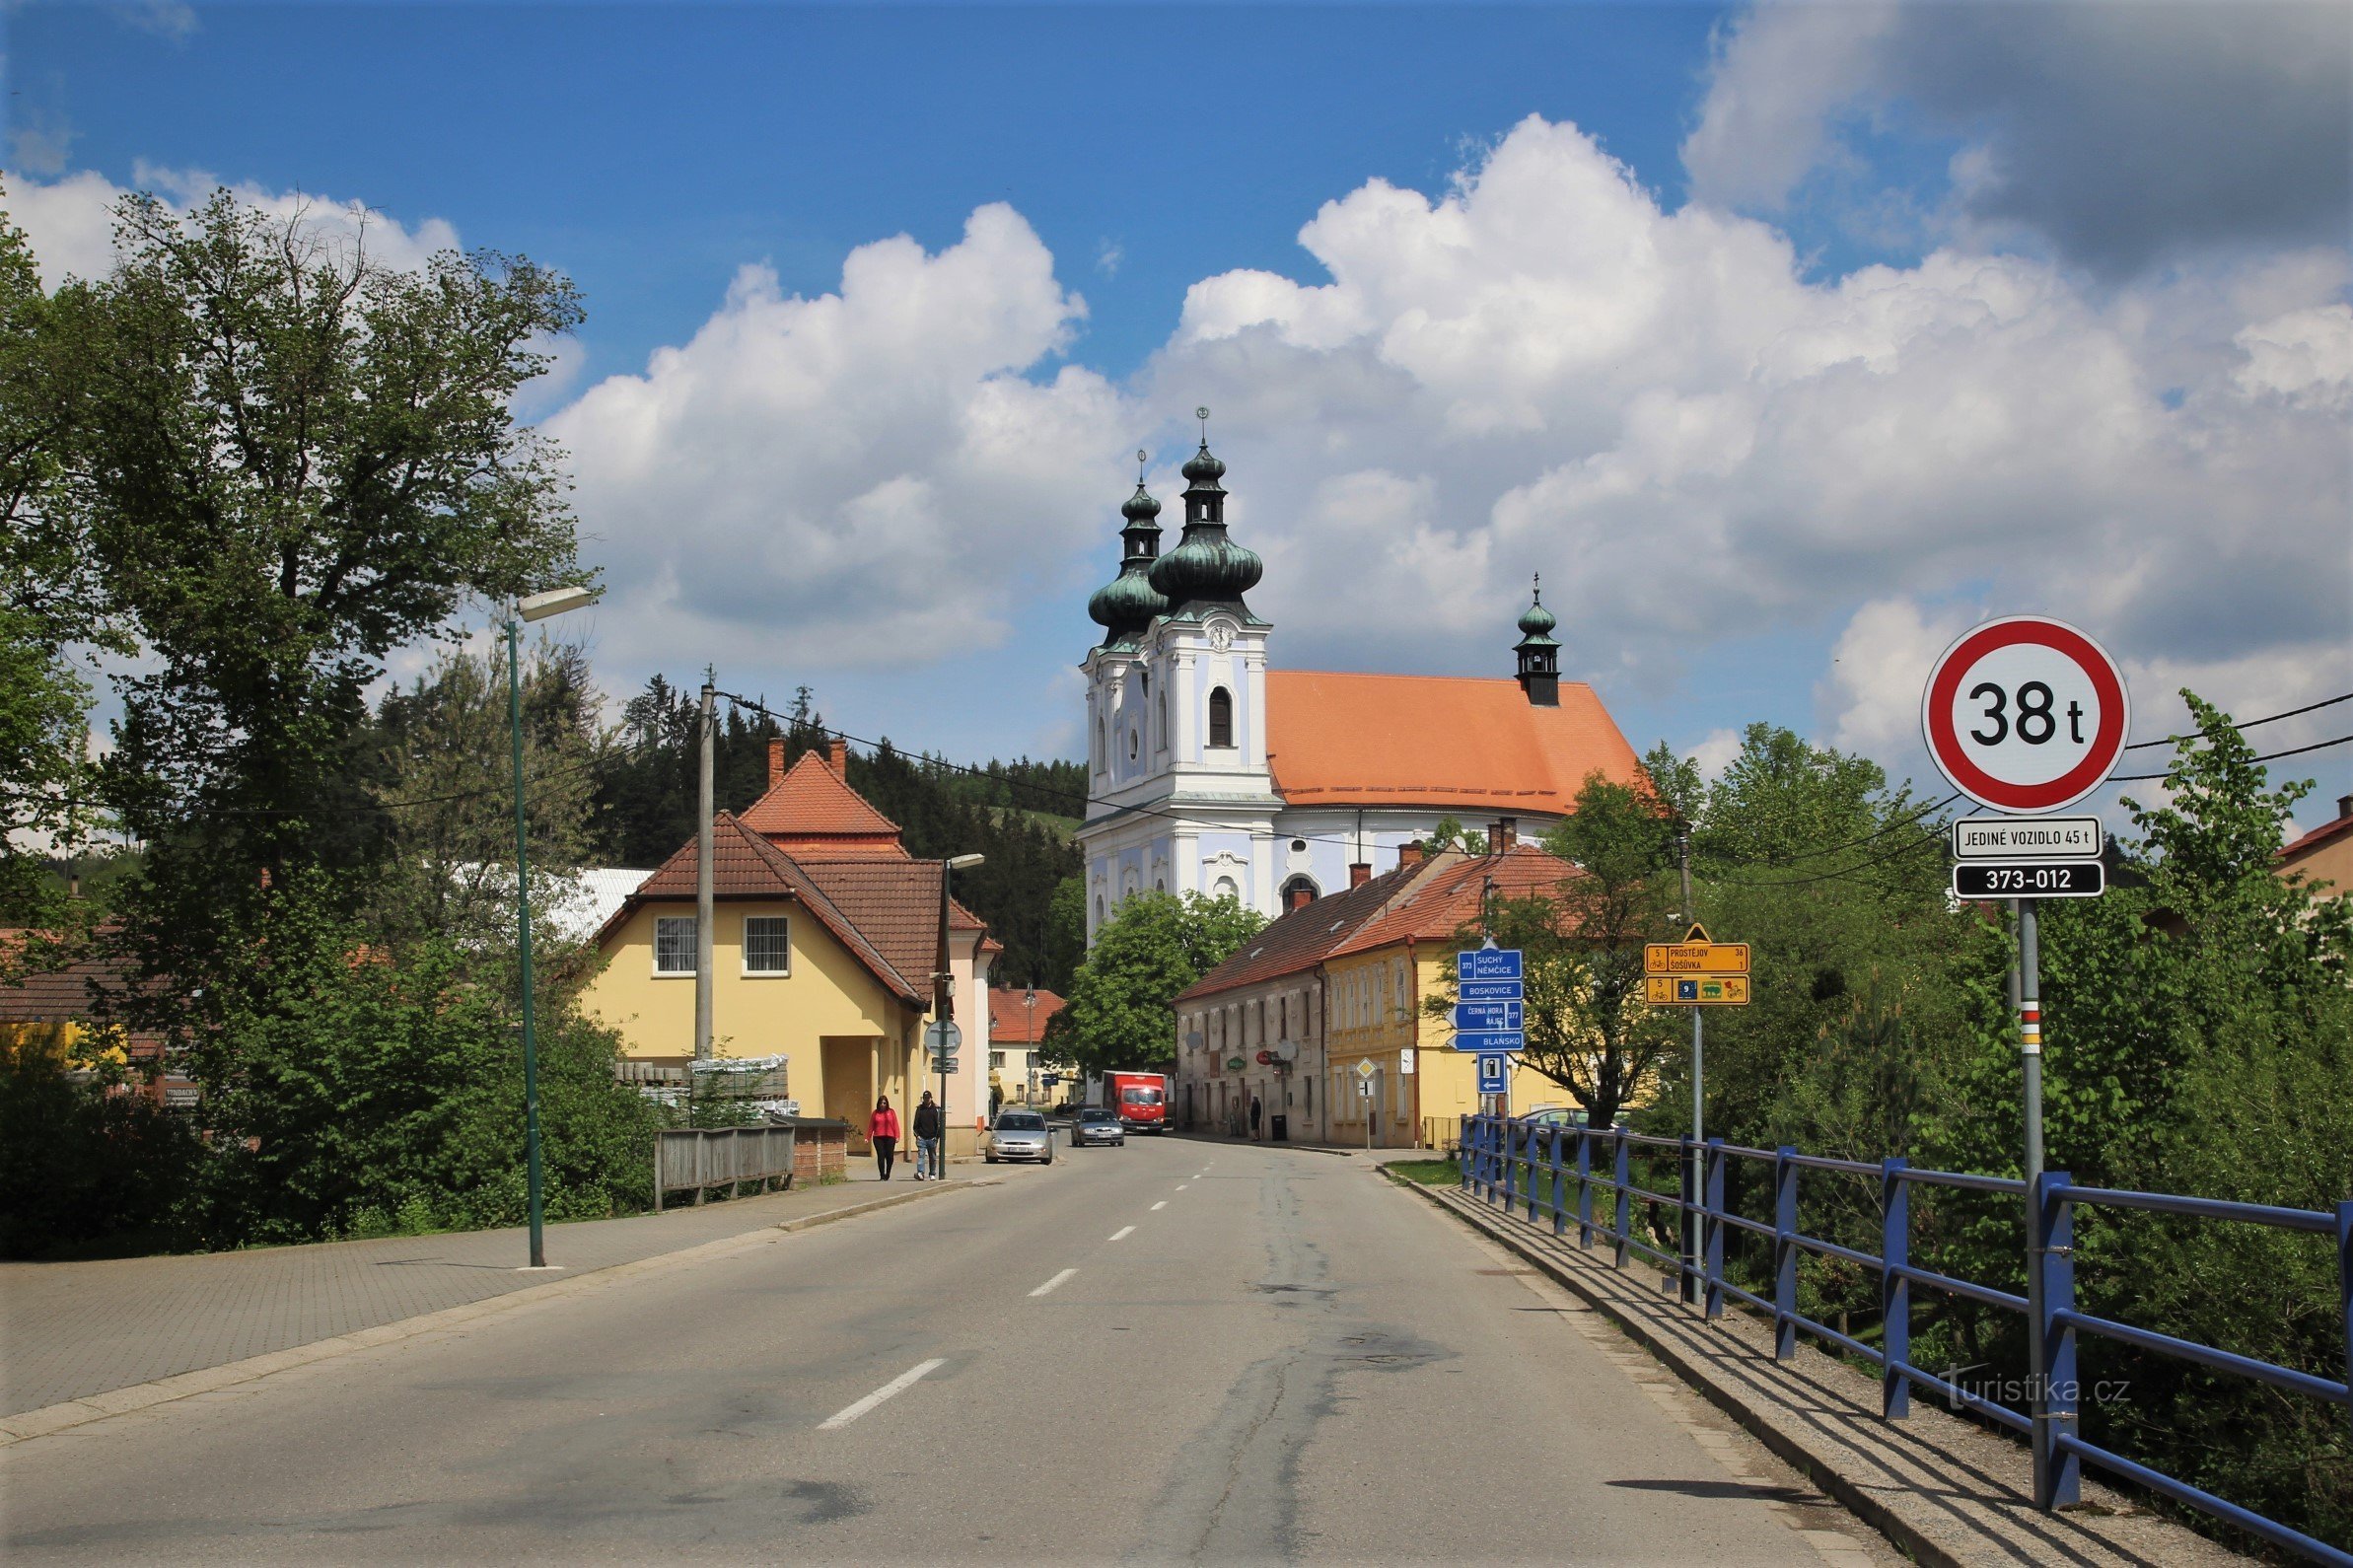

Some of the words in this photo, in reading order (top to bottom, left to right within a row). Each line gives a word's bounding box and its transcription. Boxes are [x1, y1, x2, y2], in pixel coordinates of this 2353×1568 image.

[1968, 680, 2057, 747] 38
[2067, 701, 2085, 745] t
[1964, 828, 2007, 846] JEDINÉ
[2011, 830, 2061, 845] VOZIDLO
[2065, 830, 2080, 844] 45
[2084, 831, 2090, 844] t
[1986, 869, 2072, 890] 373-012
[1670, 948, 1708, 957] PROSTĚJOV
[1476, 955, 1503, 964] SUCHÝ
[1476, 964, 1512, 974] NĚMČICE
[1670, 961, 1701, 969] ŠOŠŮVKA
[1657, 979, 1663, 988] 5
[1468, 986, 1512, 995] BOSKOVICE
[1467, 1006, 1486, 1015] ČERNÁ
[1485, 1016, 1504, 1026] RÁJEC
